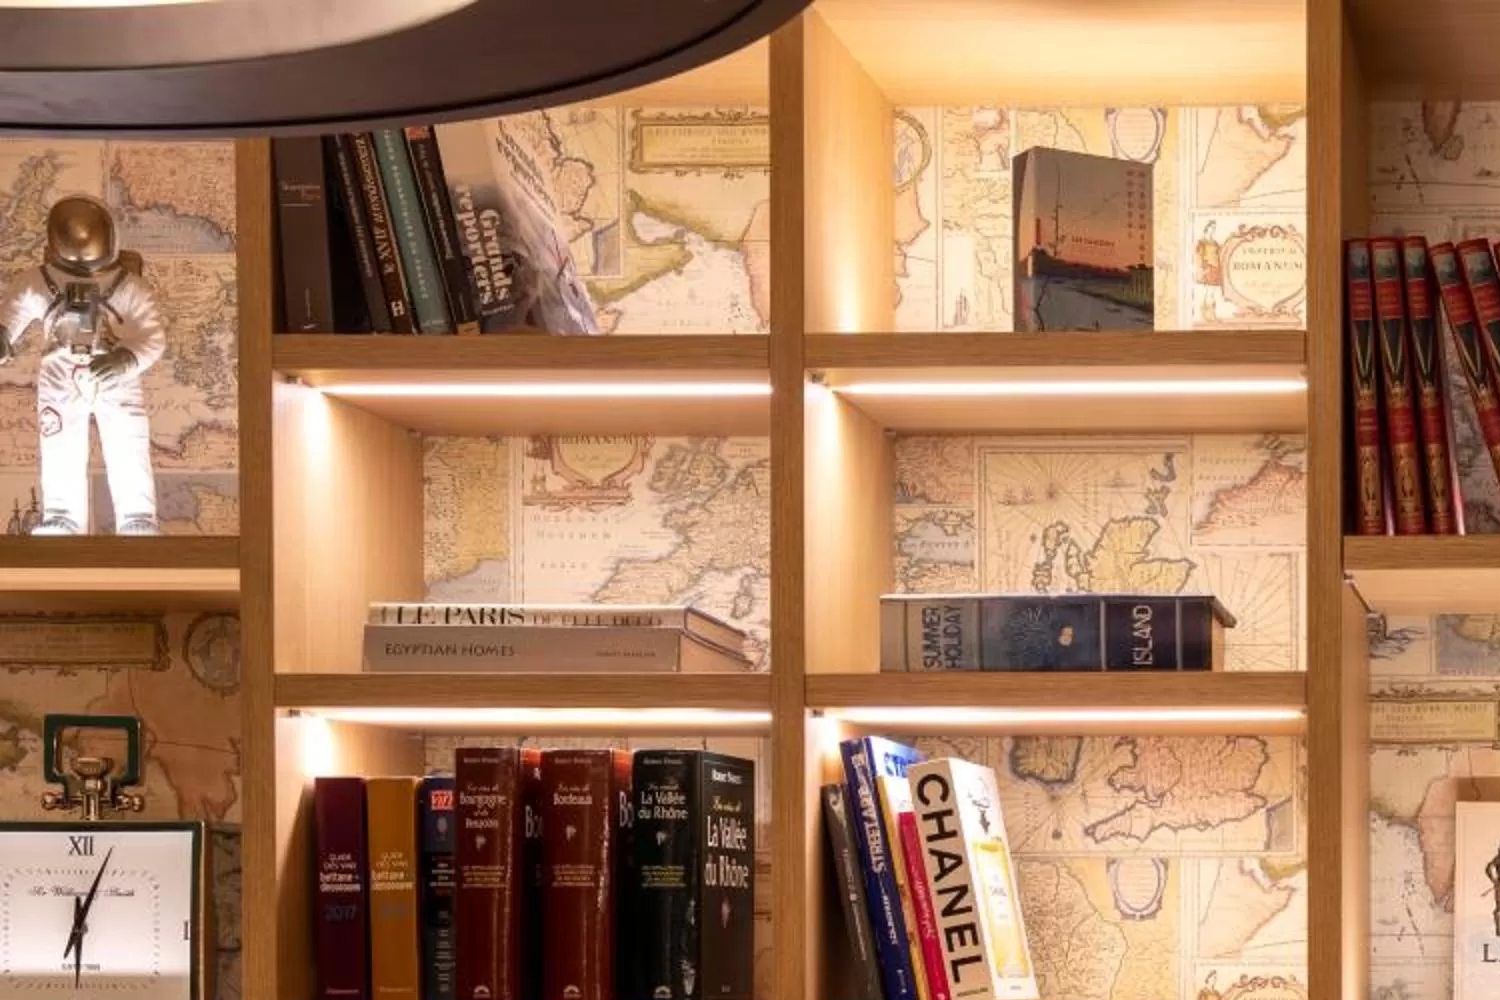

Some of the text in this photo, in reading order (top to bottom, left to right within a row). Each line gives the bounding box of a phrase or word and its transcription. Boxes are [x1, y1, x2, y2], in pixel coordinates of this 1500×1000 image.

[452, 184, 494, 305] reporters
[479, 208, 513, 301] Grands
[444, 606, 526, 625] PARIS
[922, 606, 943, 672] SUMMER
[944, 604, 963, 670] HOLIDAY
[1132, 605, 1154, 666] ISLAND
[385, 642, 516, 657] EGYPTIAN HOMES
[653, 805, 689, 819] Rhône
[707, 815, 719, 848] La
[68, 836, 95, 857] XII
[719, 855, 750, 889] Rhône
[916, 773, 984, 985] CHANEL
